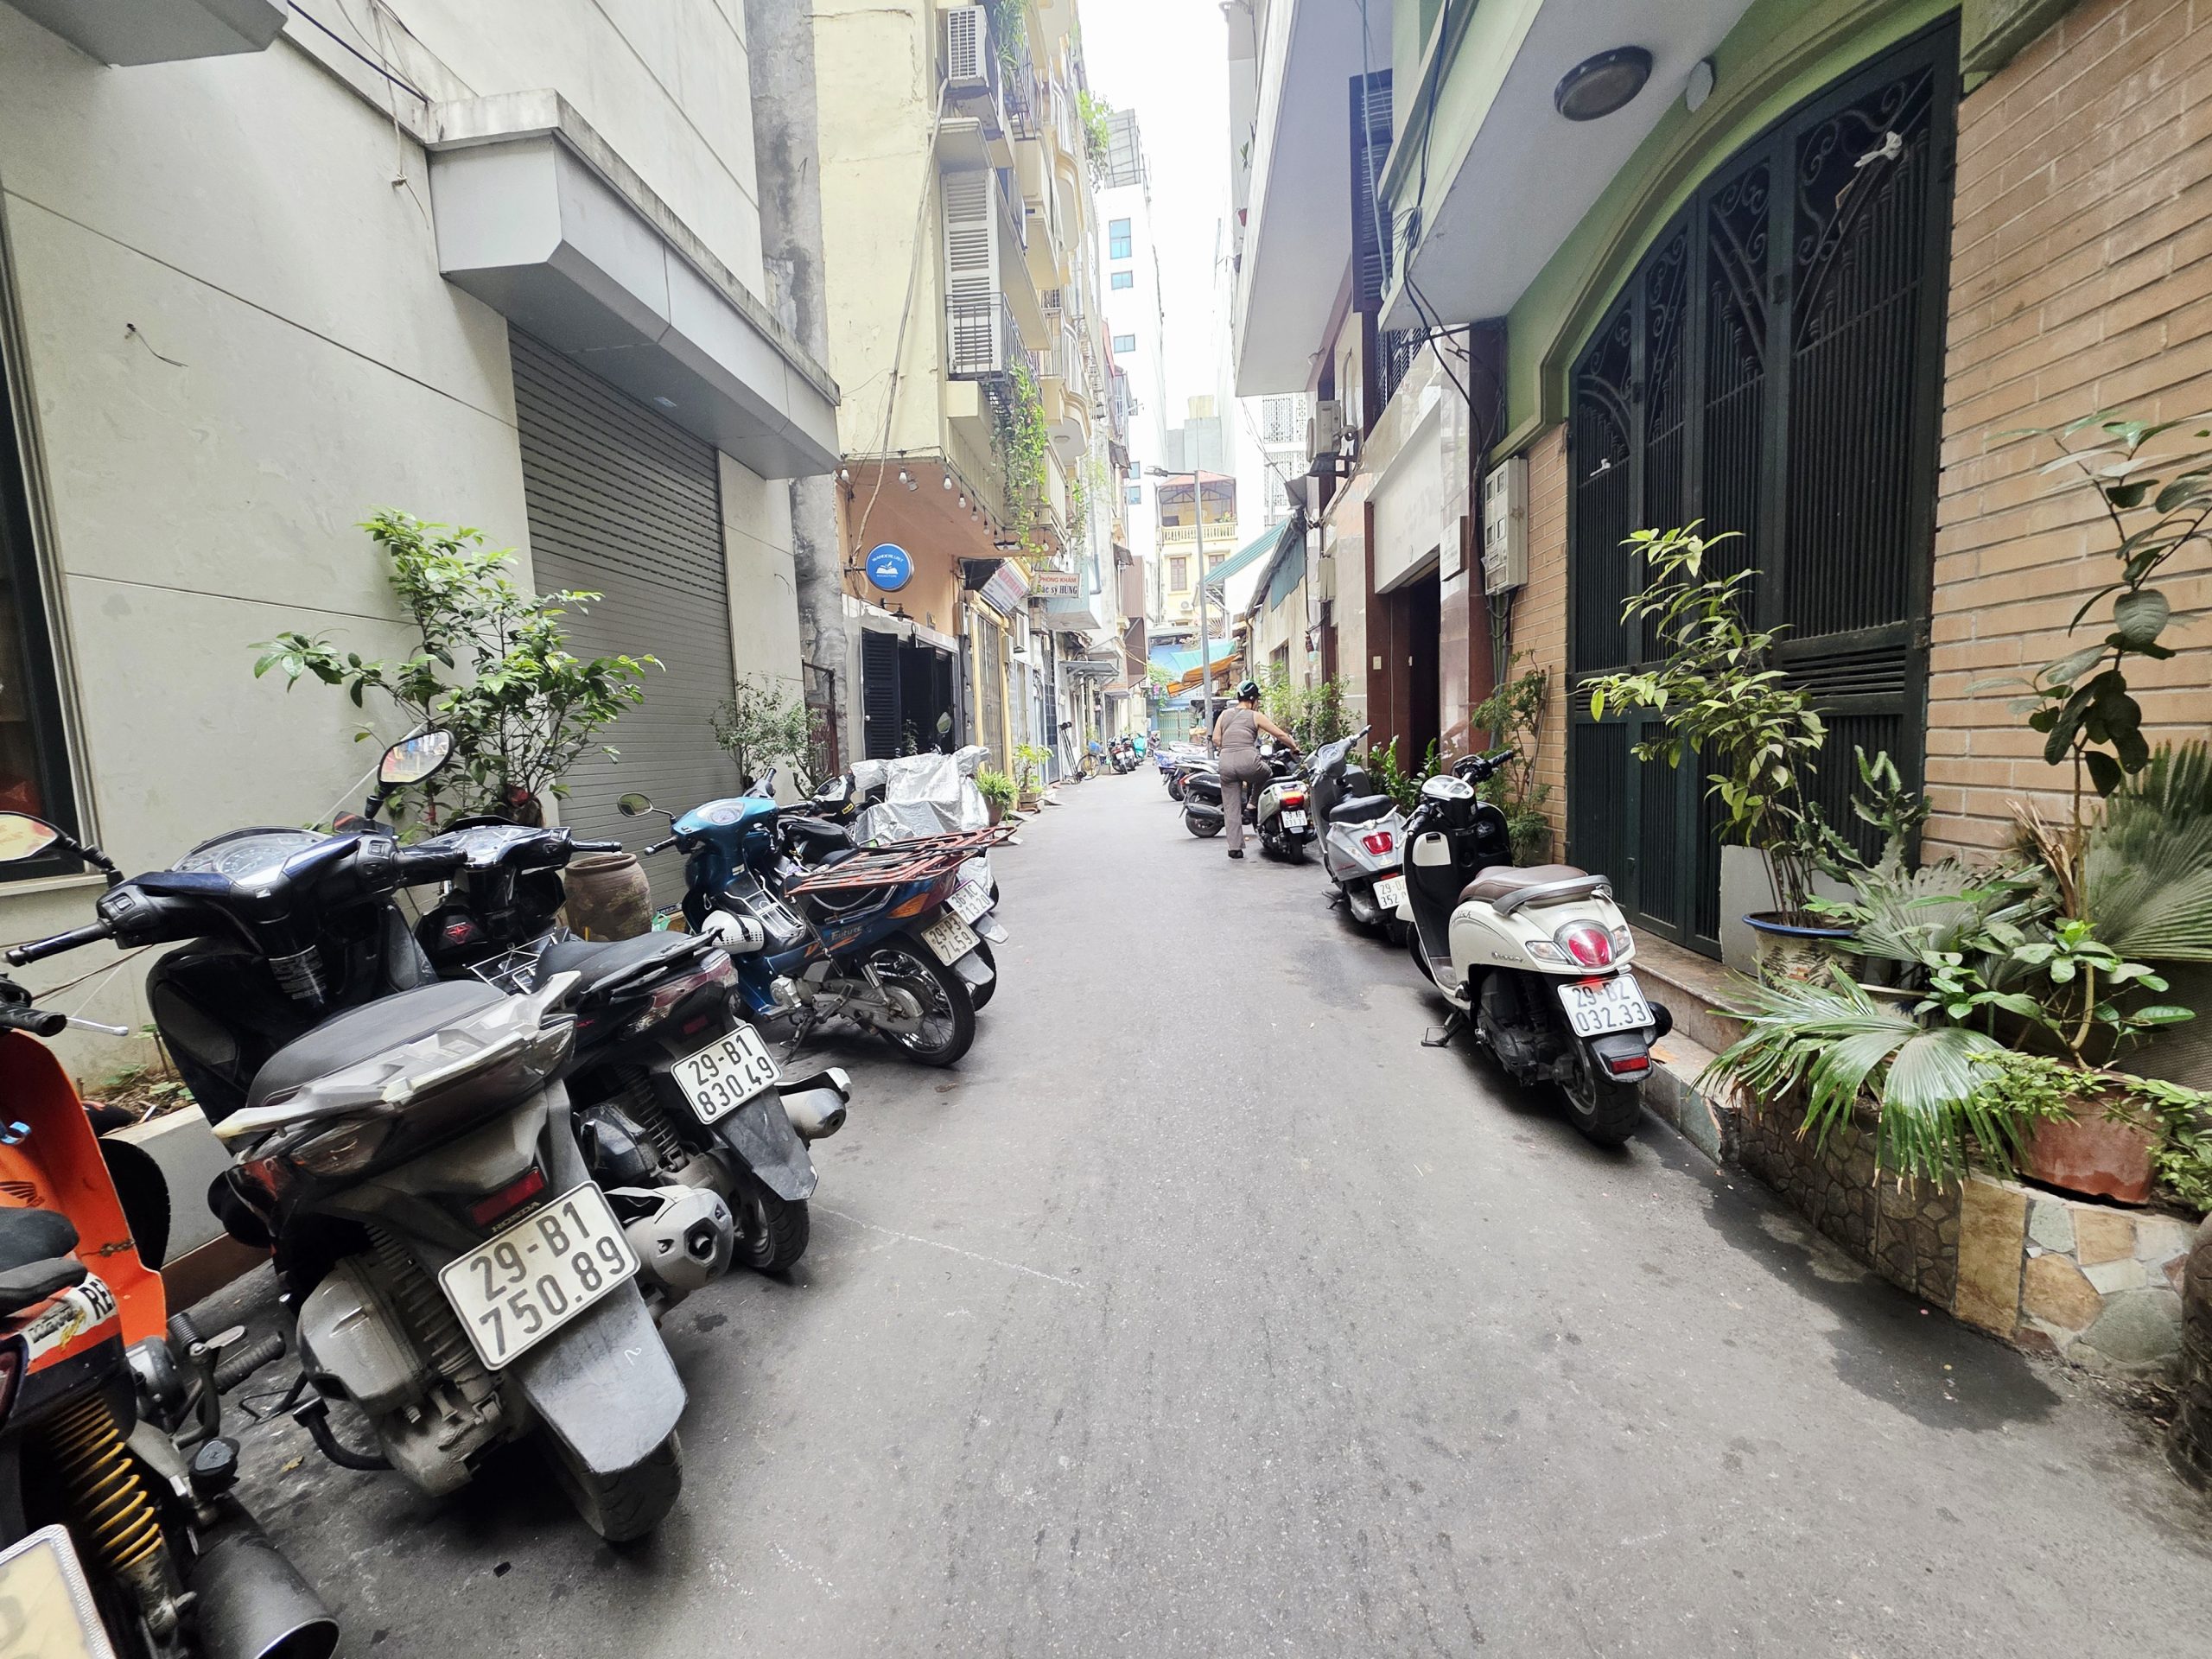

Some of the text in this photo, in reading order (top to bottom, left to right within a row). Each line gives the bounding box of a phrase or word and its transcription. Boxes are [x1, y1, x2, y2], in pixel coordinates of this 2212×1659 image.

[960, 894, 990, 922] 713.20
[941, 931, 973, 960] 7459
[1572, 980, 1630, 1007] 29-B2
[1575, 1001, 1646, 1032] 032.33
[688, 1034, 753, 1086] 29-B1
[697, 1056, 774, 1116] 830.49
[492, 1201, 541, 1234] HONDA
[469, 1201, 591, 1302] 29-B1
[478, 1236, 626, 1357] 750.89
